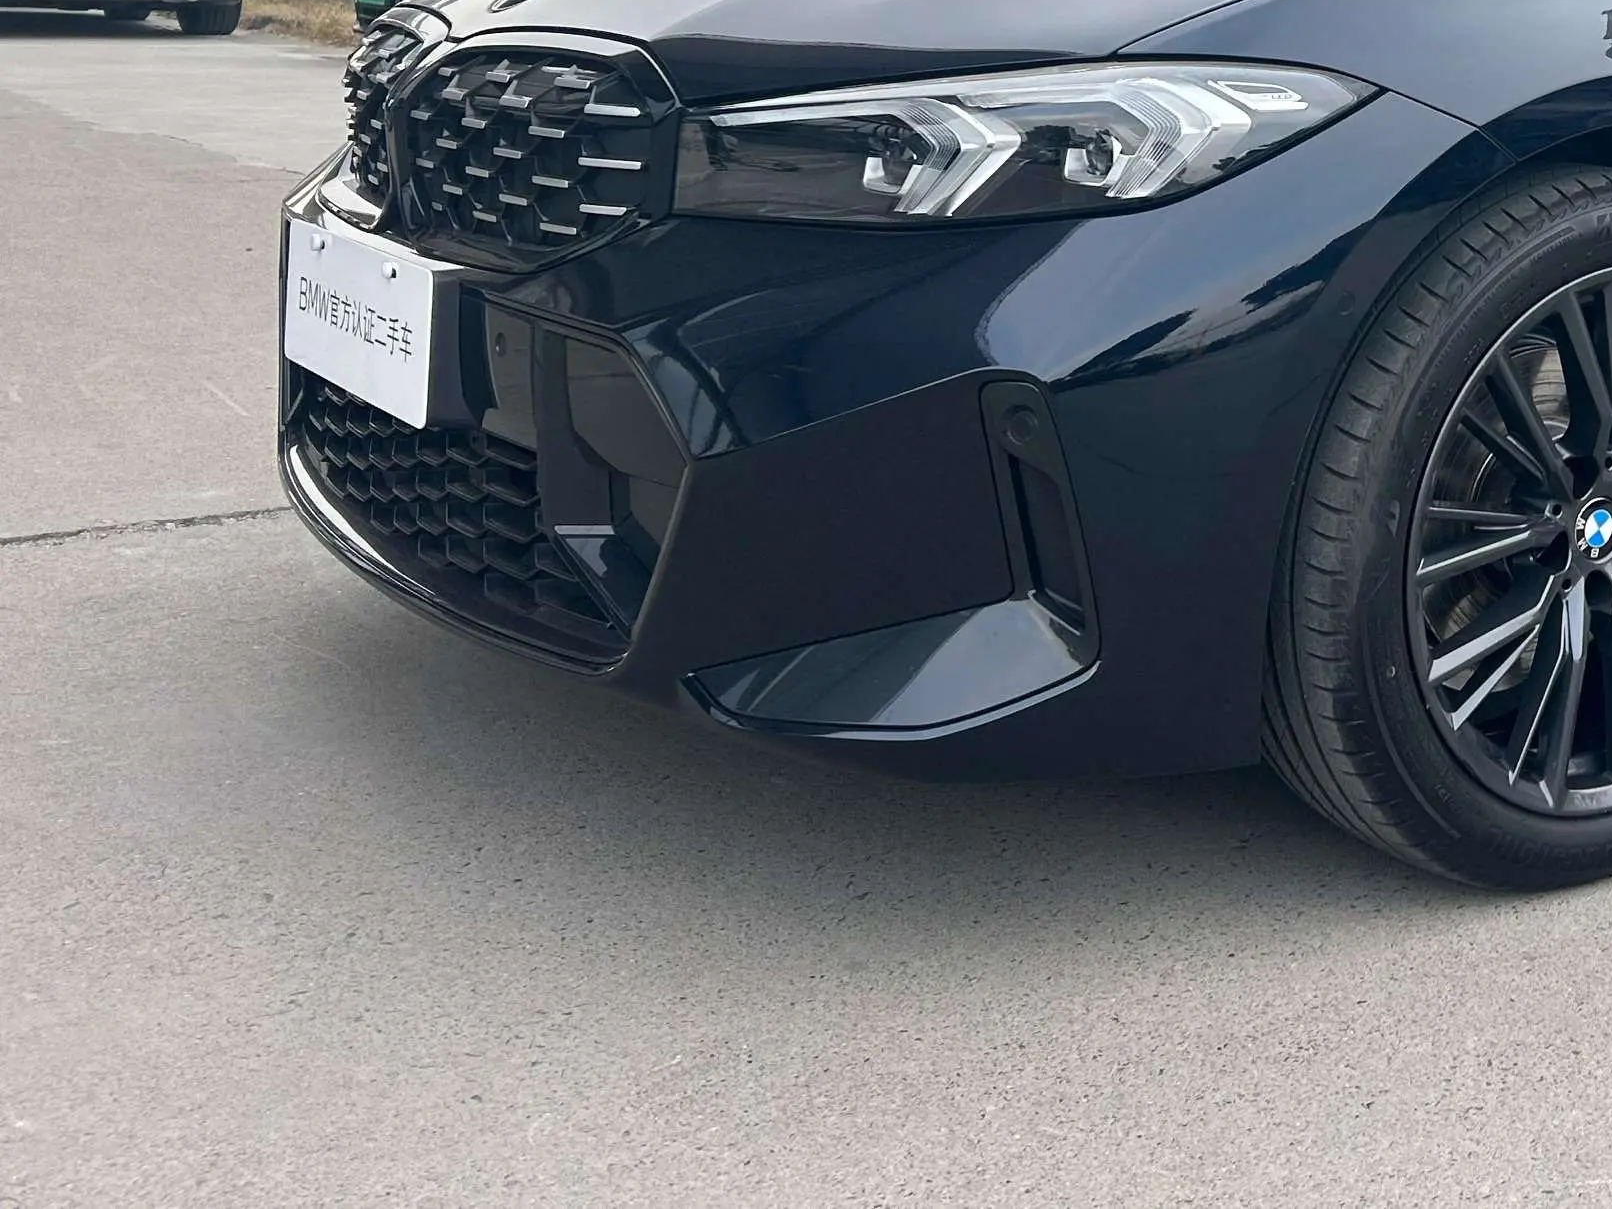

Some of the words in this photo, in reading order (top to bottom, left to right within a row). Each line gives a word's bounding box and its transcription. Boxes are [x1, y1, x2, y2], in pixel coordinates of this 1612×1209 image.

[299, 276, 413, 363] BMW官方认证二手车
